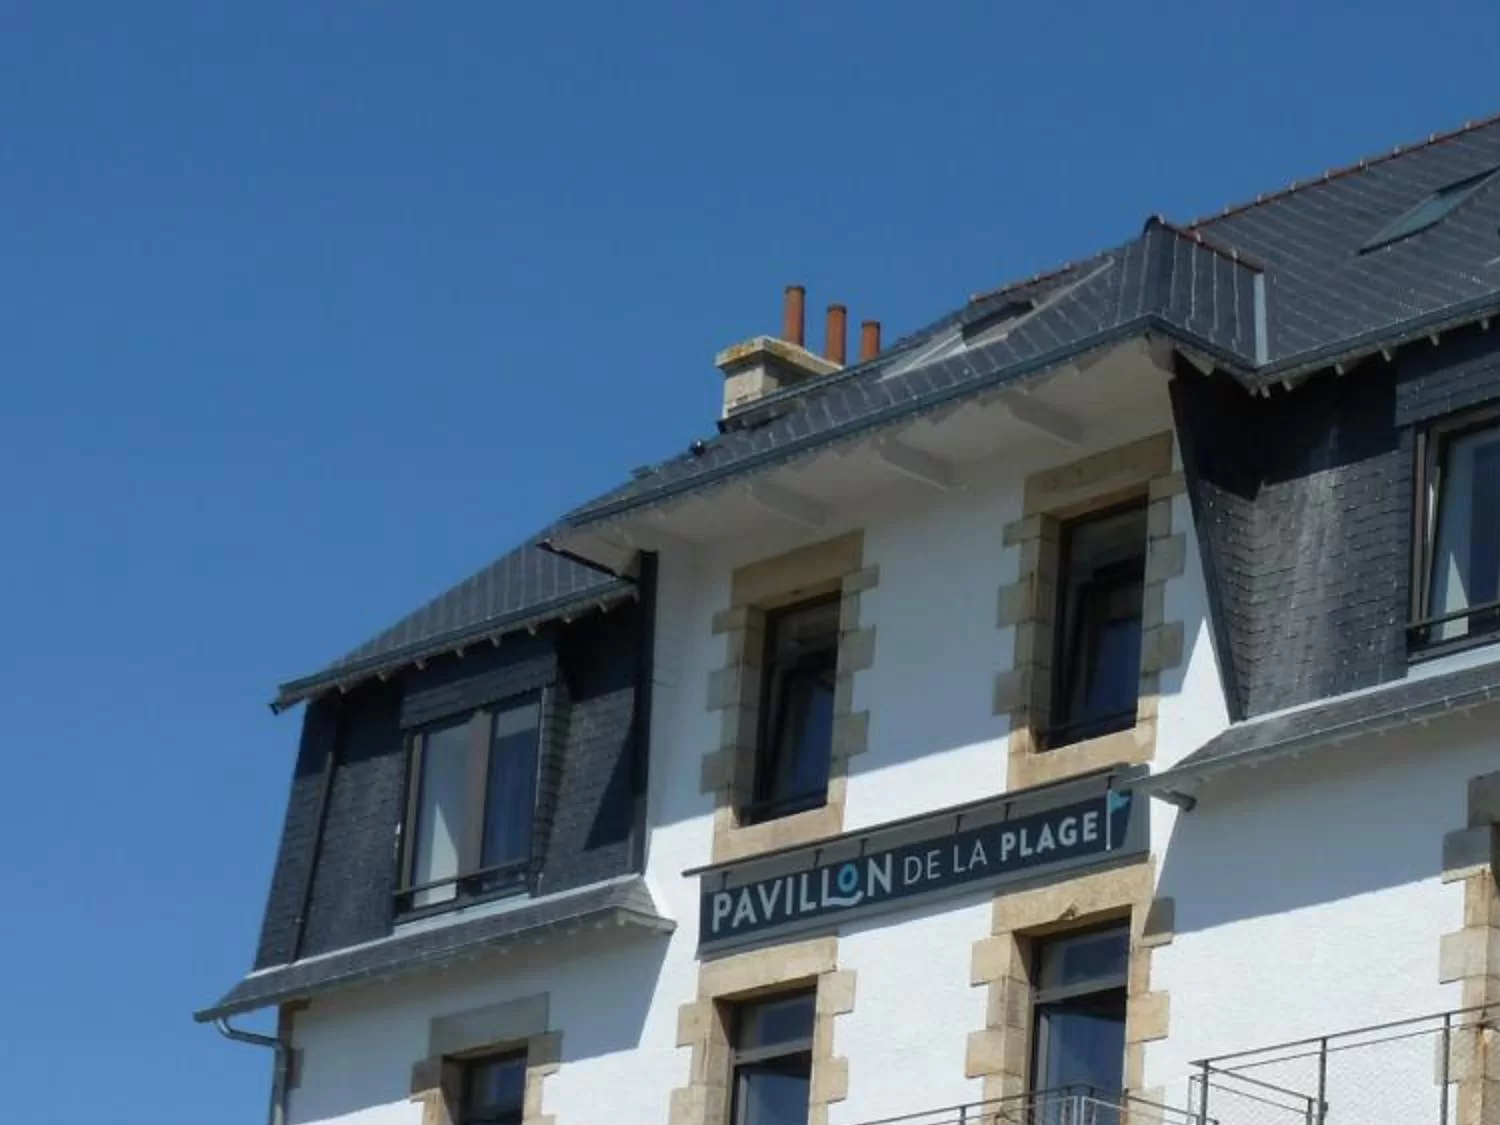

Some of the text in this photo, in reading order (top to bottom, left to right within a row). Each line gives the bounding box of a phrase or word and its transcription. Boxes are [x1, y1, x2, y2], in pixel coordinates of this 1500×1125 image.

[711, 811, 1099, 933] PAVILLON DE LA PLAGE
